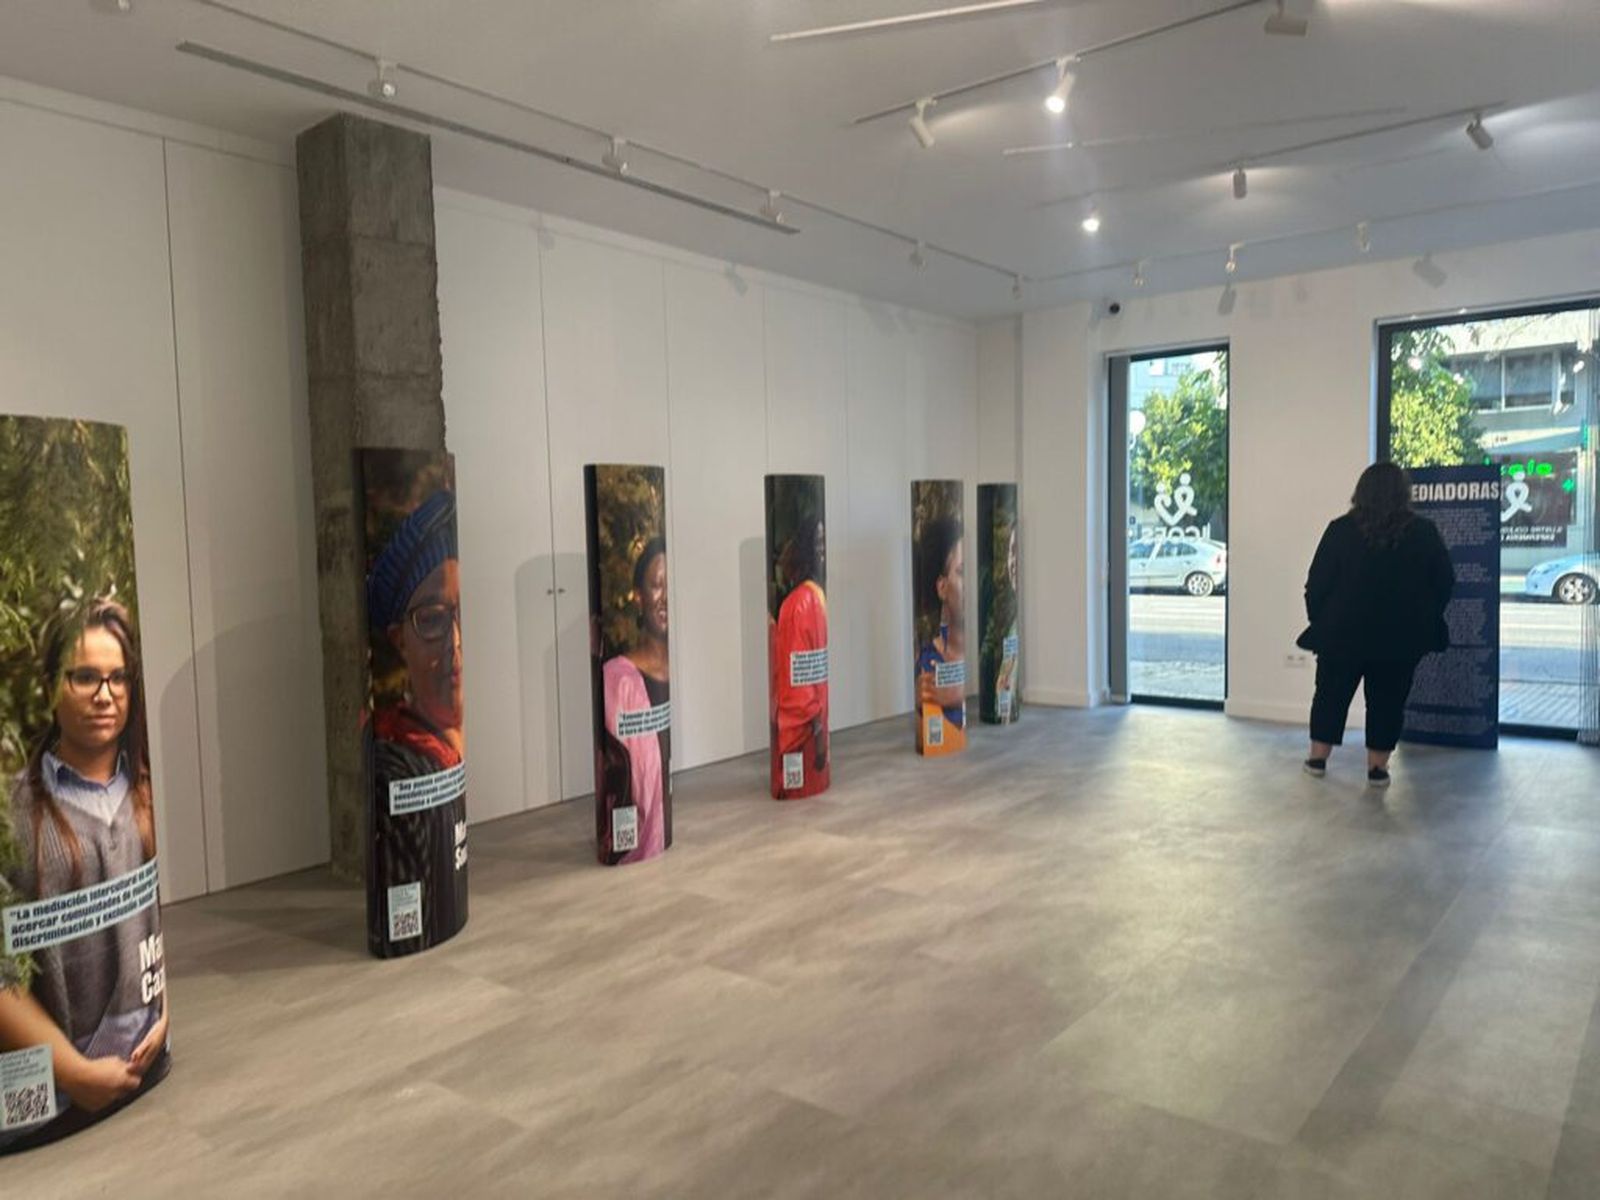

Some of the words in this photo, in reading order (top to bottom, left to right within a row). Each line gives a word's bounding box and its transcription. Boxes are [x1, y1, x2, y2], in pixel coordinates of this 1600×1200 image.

[1411, 481, 1499, 502] EDIADORAS
[11, 915, 59, 935] acercar
[61, 894, 121, 923] comunidades
[33, 892, 88, 916] mediación
[12, 915, 94, 948] discriminación
